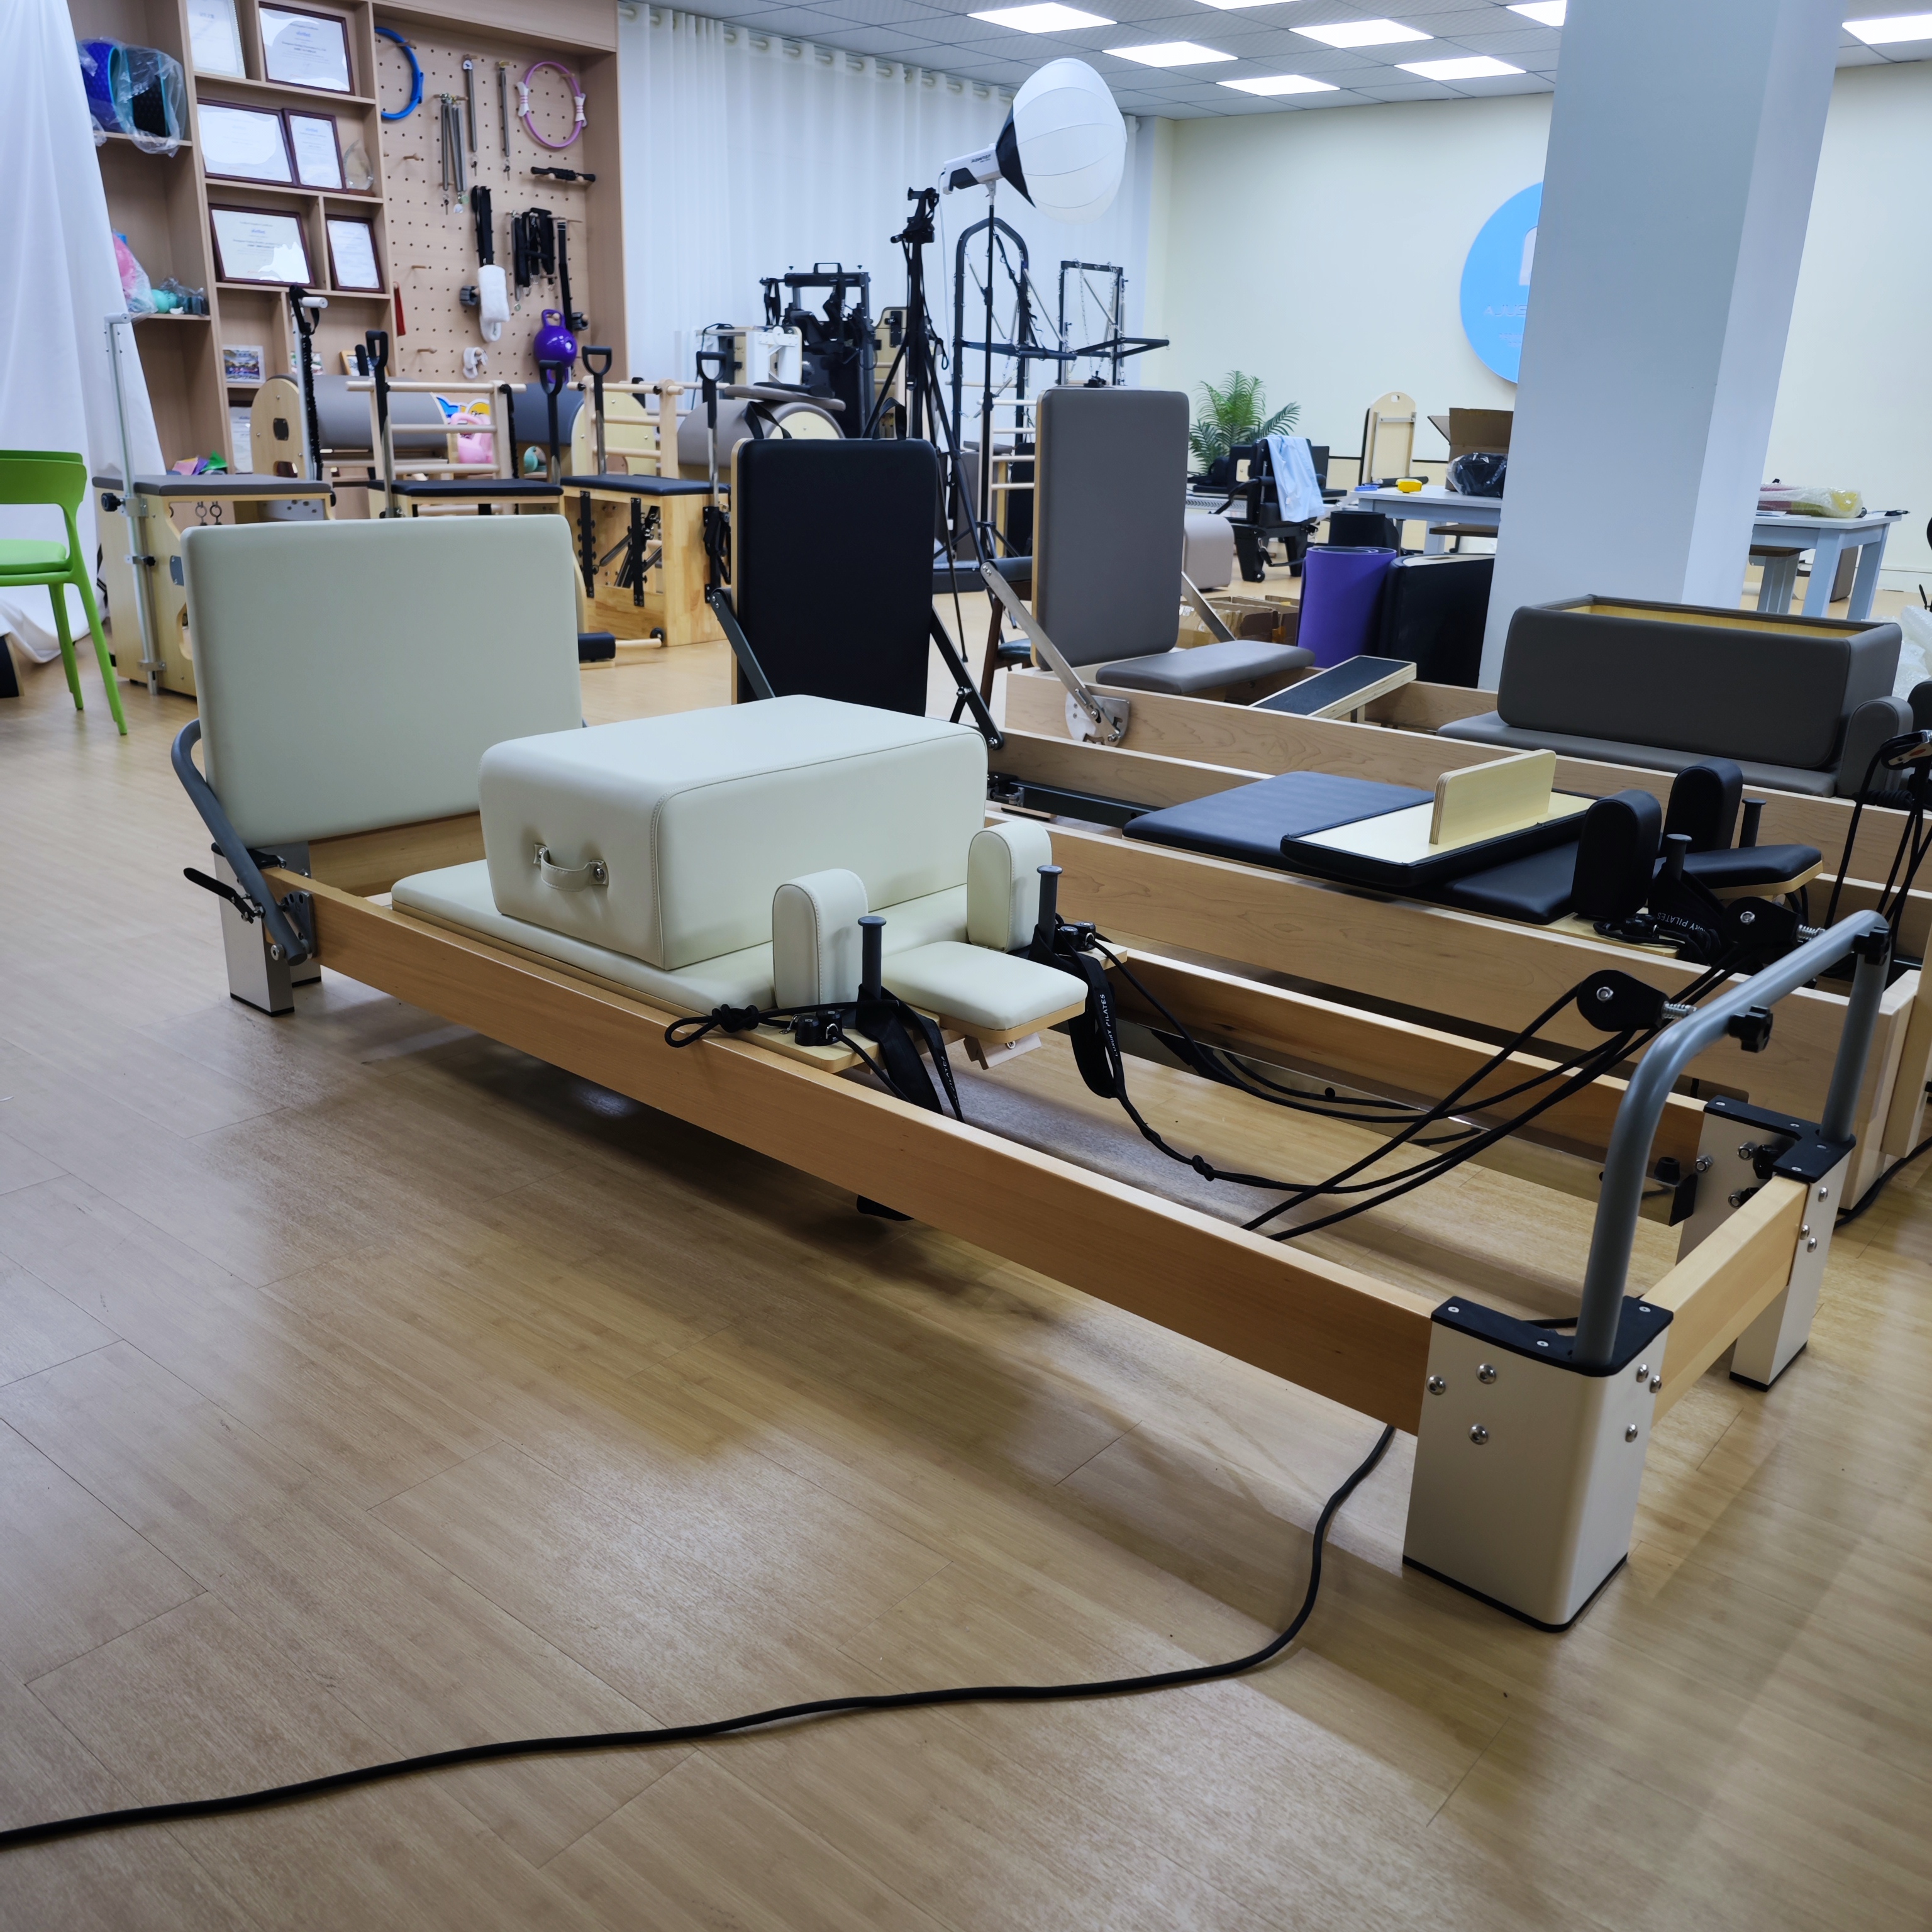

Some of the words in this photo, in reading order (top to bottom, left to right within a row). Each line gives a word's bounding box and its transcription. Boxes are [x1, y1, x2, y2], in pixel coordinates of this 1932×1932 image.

[1657, 912, 1689, 928] PILATES
[1099, 994, 1111, 1027] PILATES
[1107, 1029, 1118, 1057] LUXURY
